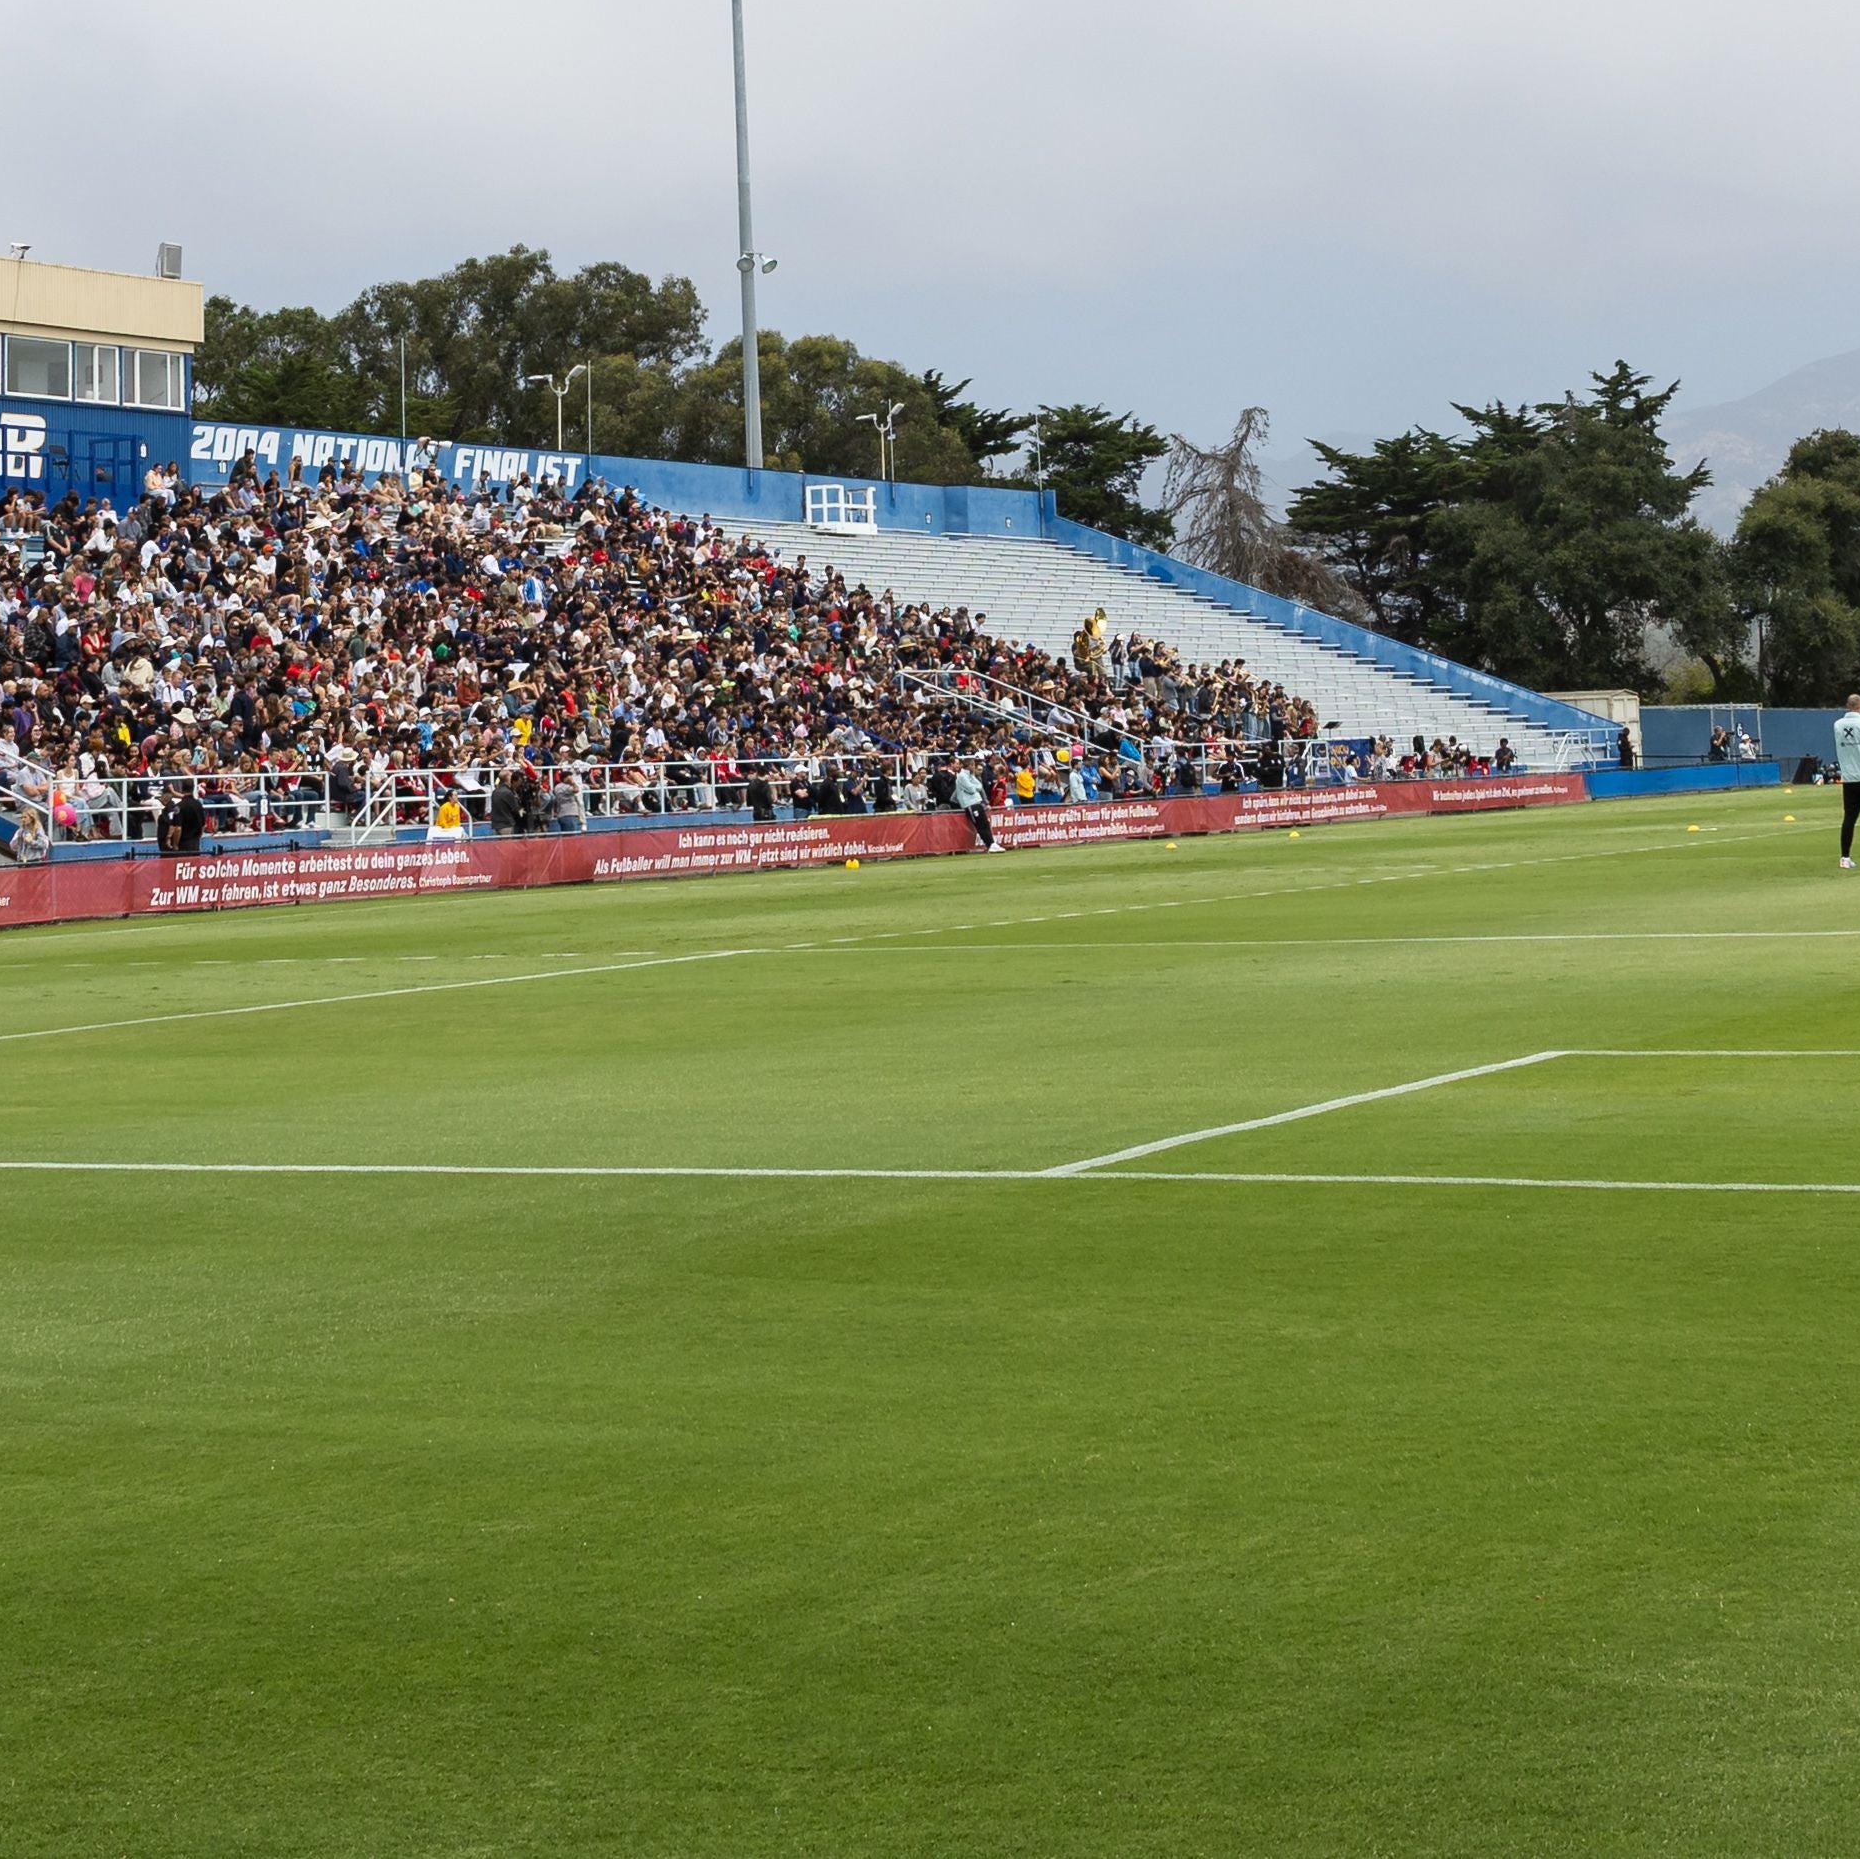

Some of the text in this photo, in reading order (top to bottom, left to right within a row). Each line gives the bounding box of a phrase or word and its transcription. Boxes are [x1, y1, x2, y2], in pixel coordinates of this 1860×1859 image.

[191, 426, 280, 465] 2004
[454, 447, 581, 487] FINALIST
[678, 833, 692, 849] Ich
[693, 832, 715, 848] kann
[716, 834, 726, 846] es
[726, 830, 749, 846] noch
[749, 833, 764, 847] gar
[764, 827, 786, 844] nicht
[175, 847, 470, 881] Für solche Momente arbeitest du dein ganzes Leben.
[594, 859, 609, 876] Als
[610, 855, 654, 874] Fußballer
[654, 854, 672, 870] will
[671, 856, 690, 869] man
[691, 852, 719, 867] immer
[720, 852, 735, 866] zur
[735, 849, 752, 864] WM
[757, 846, 780, 866] jetzt
[780, 845, 799, 862] sind
[799, 844, 812, 859] wir
[812, 842, 843, 859] wirklich
[843, 840, 867, 856] dabei.
[150, 887, 175, 906] Zur
[176, 885, 198, 905] WM
[201, 887, 220, 903] zu
[281, 880, 317, 897] etwas
[319, 879, 347, 899] ganz
[348, 873, 417, 893] Besonderes.
